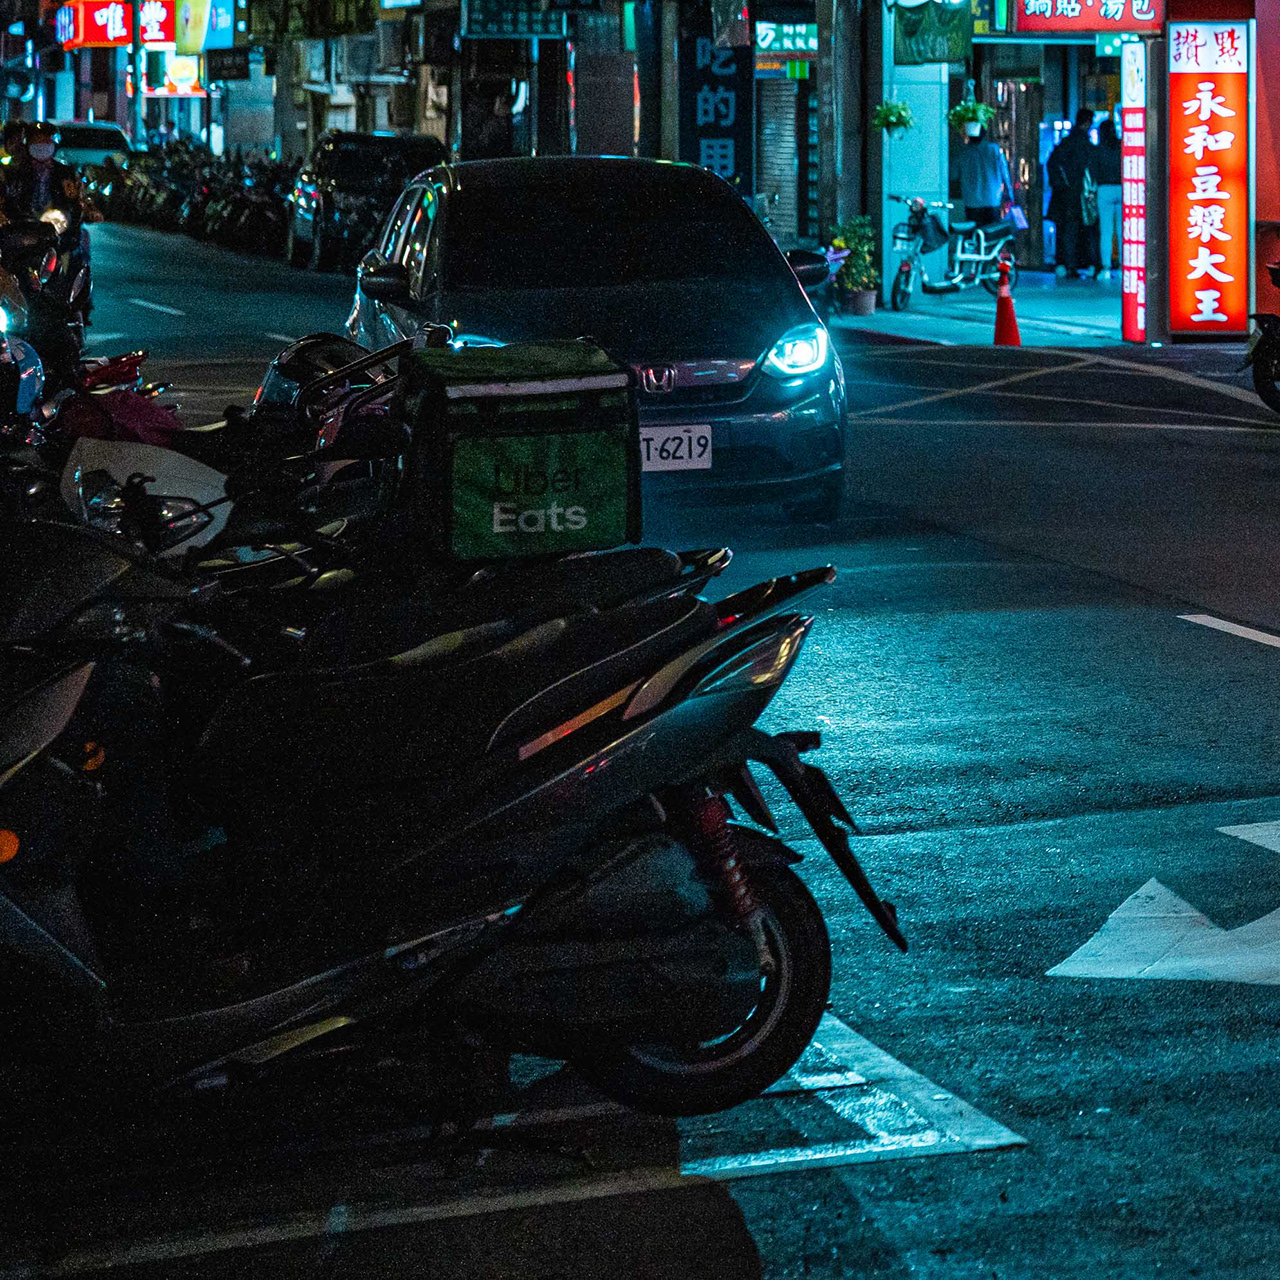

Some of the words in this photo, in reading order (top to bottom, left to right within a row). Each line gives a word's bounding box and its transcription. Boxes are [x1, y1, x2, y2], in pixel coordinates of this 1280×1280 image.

[1172, 27, 1242, 68] 讚點
[1181, 81, 1237, 323] 永和豆漿大王
[493, 464, 583, 496] Uber
[493, 501, 588, 534] Eats
